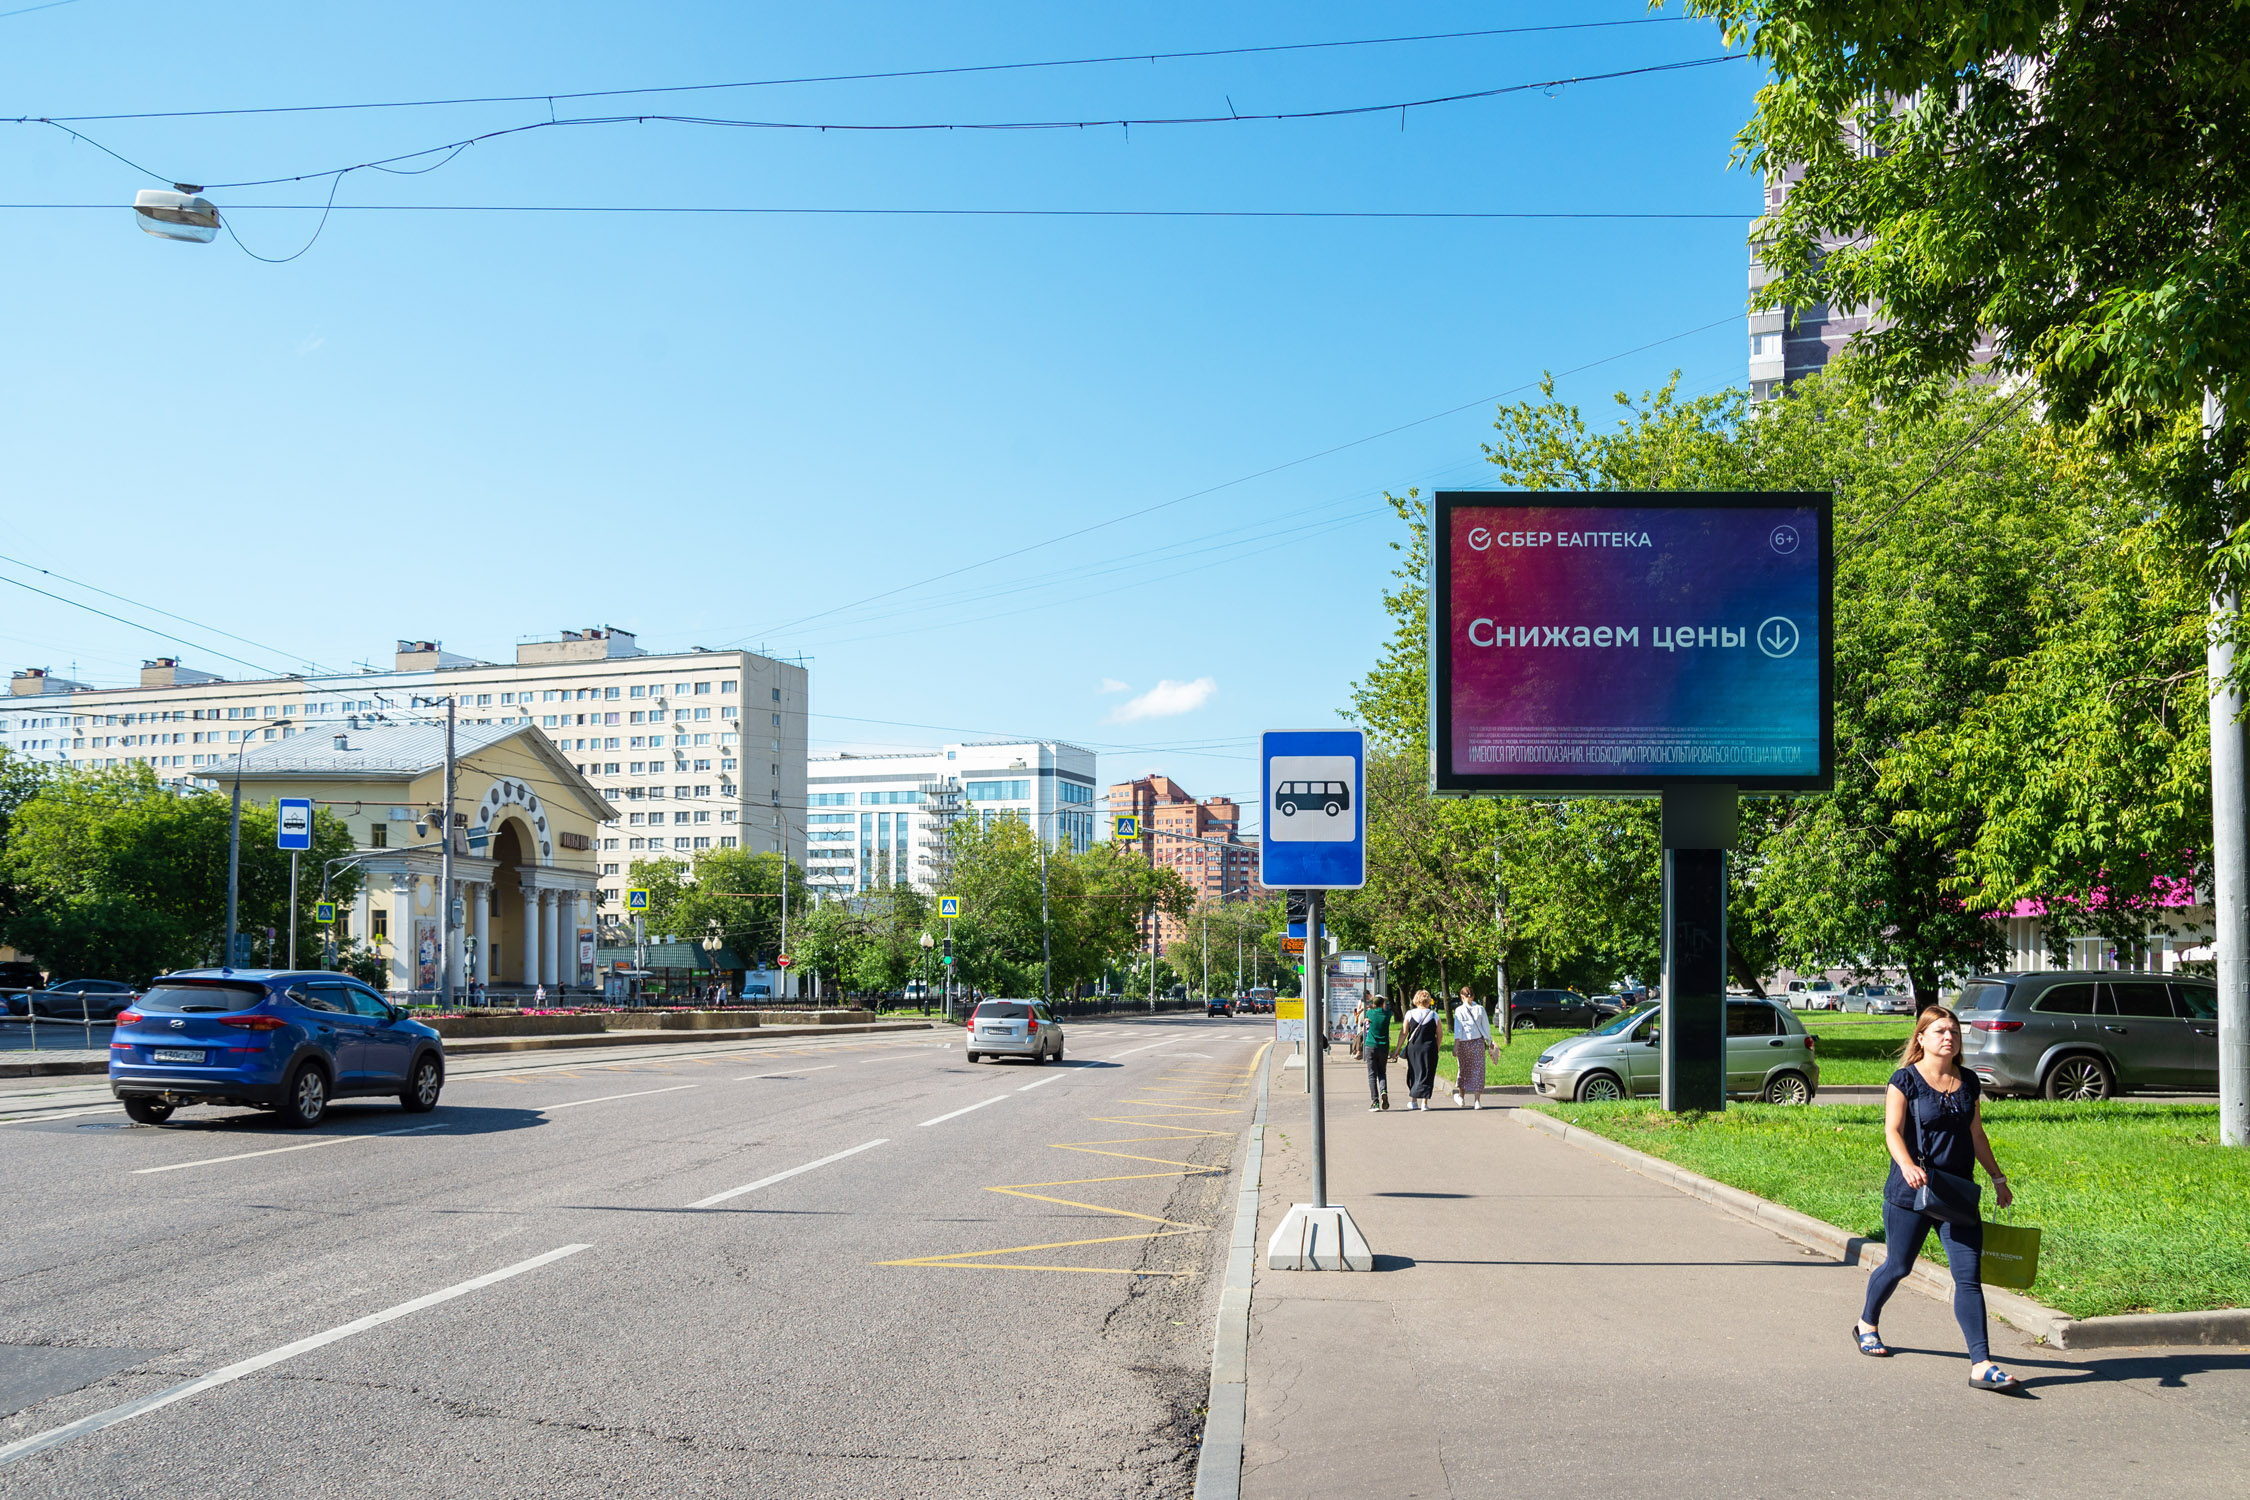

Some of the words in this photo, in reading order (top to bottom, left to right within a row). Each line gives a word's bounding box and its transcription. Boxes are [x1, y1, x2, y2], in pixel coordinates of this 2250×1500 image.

[1497, 531, 1552, 548] СБЕР
[1557, 531, 1653, 548] ЕАПТЕКА
[1774, 532, 1795, 547] 6+
[1468, 618, 1638, 648] Снижаем
[1653, 626, 1747, 653] цены
[1468, 745, 1505, 763] ИМЕЮТСЯ
[1505, 745, 1585, 763] ПРОТИВОПОКАЗАНИЯ.
[1585, 745, 1637, 766] НЕОБХОДИМО
[1638, 746, 1729, 763] ПРОКОНСУЛЬТИРОВАТЬСЯ
[1730, 746, 1741, 763] СО
[1741, 746, 1801, 765] СПЕЦИАЛИСТОМ.
